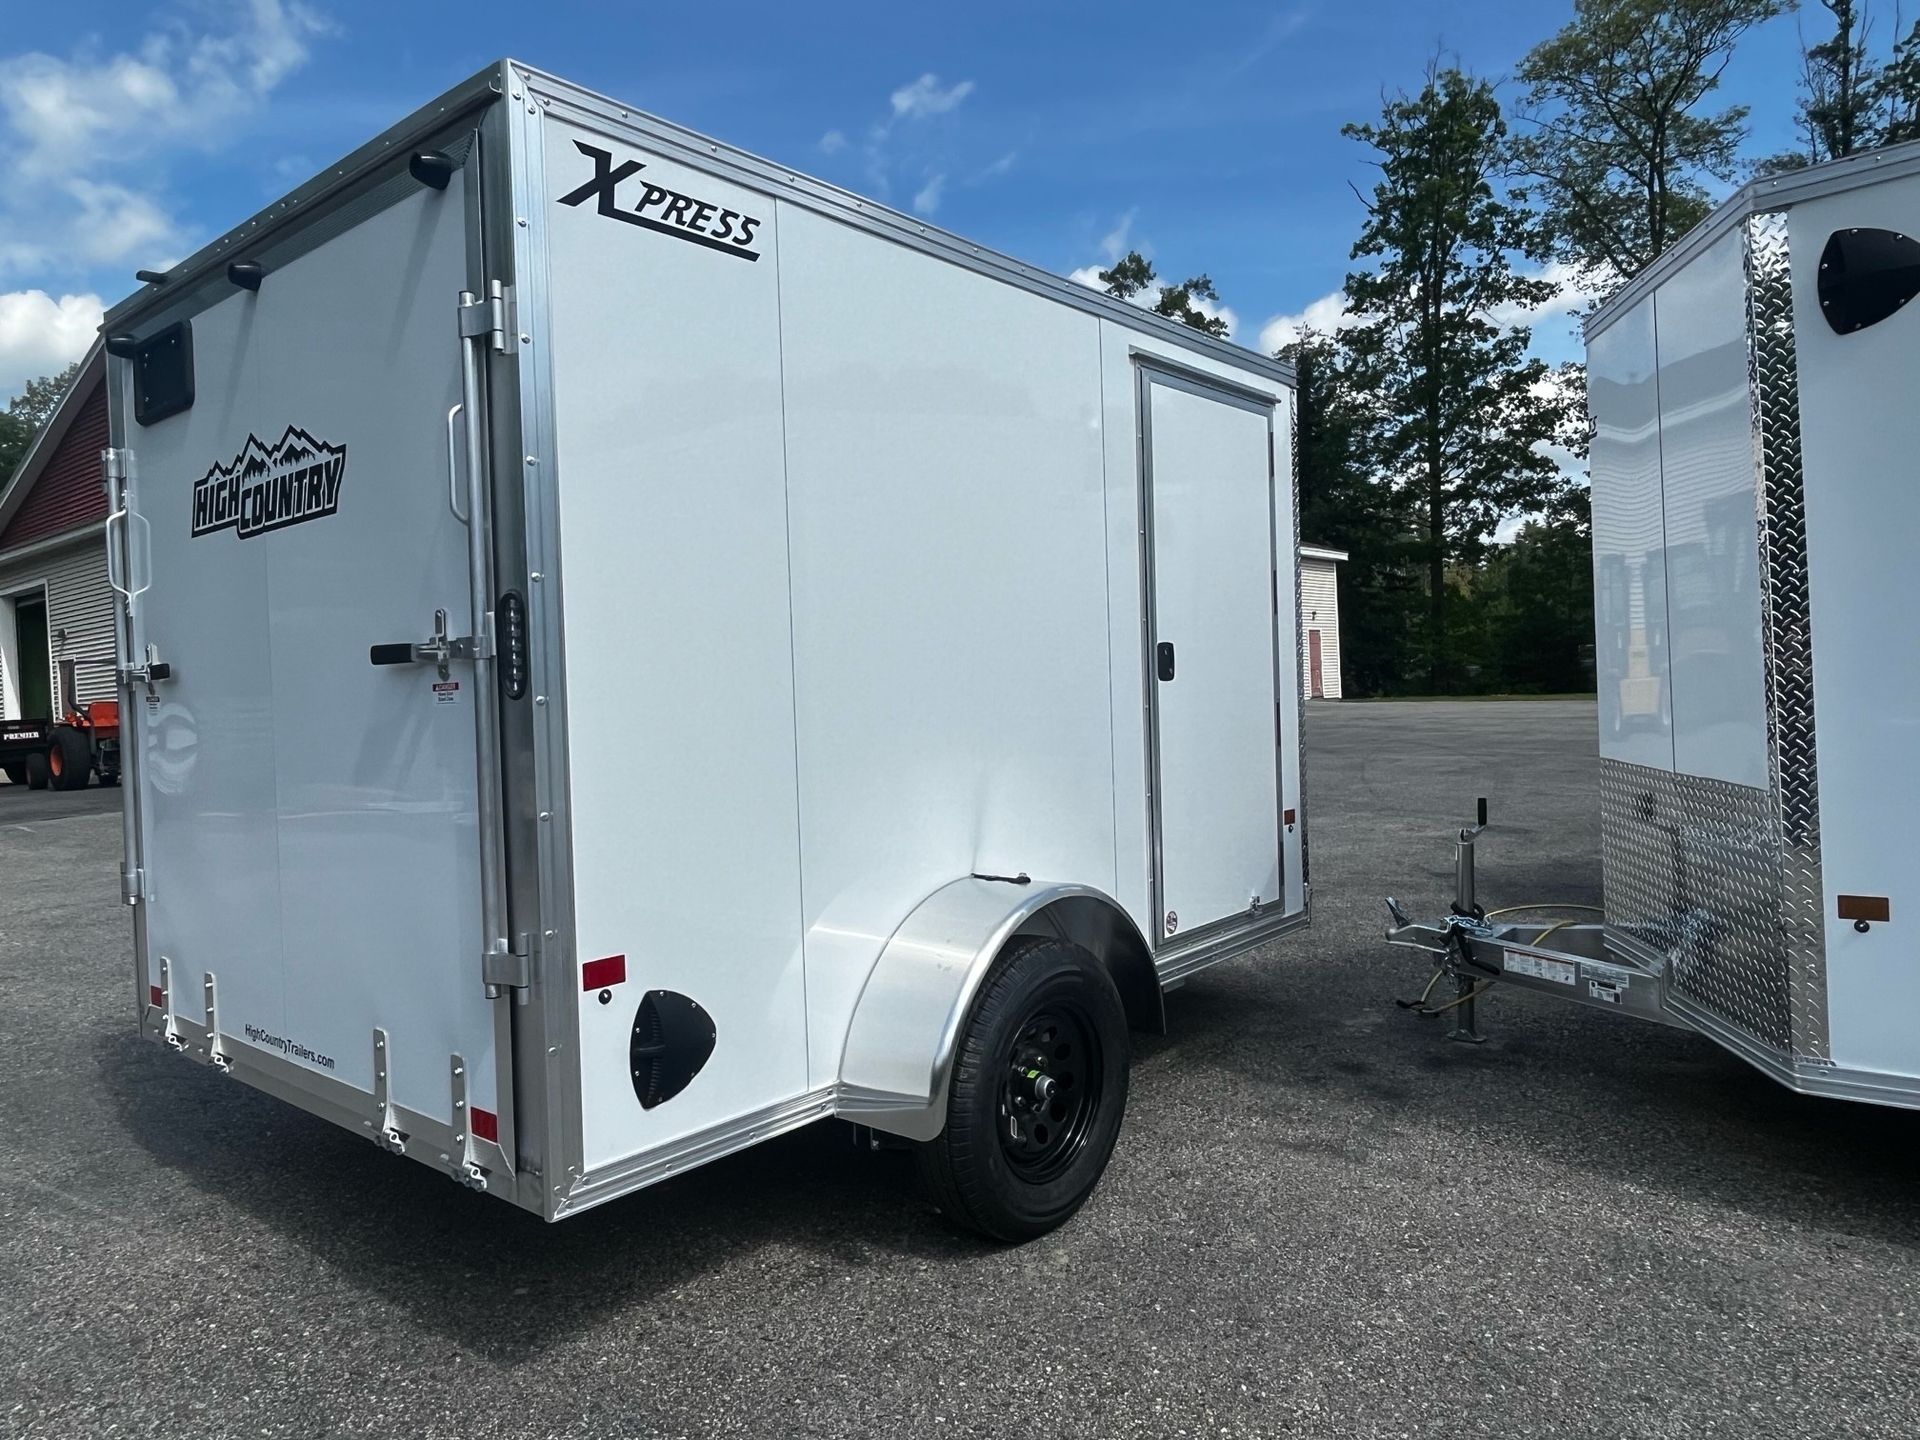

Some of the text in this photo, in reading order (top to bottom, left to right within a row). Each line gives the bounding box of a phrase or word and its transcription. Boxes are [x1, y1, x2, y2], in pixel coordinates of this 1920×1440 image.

[556, 139, 761, 262] XPRESS
[195, 457, 341, 531] HIGH COUNTRY
[3, 731, 39, 740] PREMIER
[245, 1024, 335, 1069] HighCountryTrailers.com
